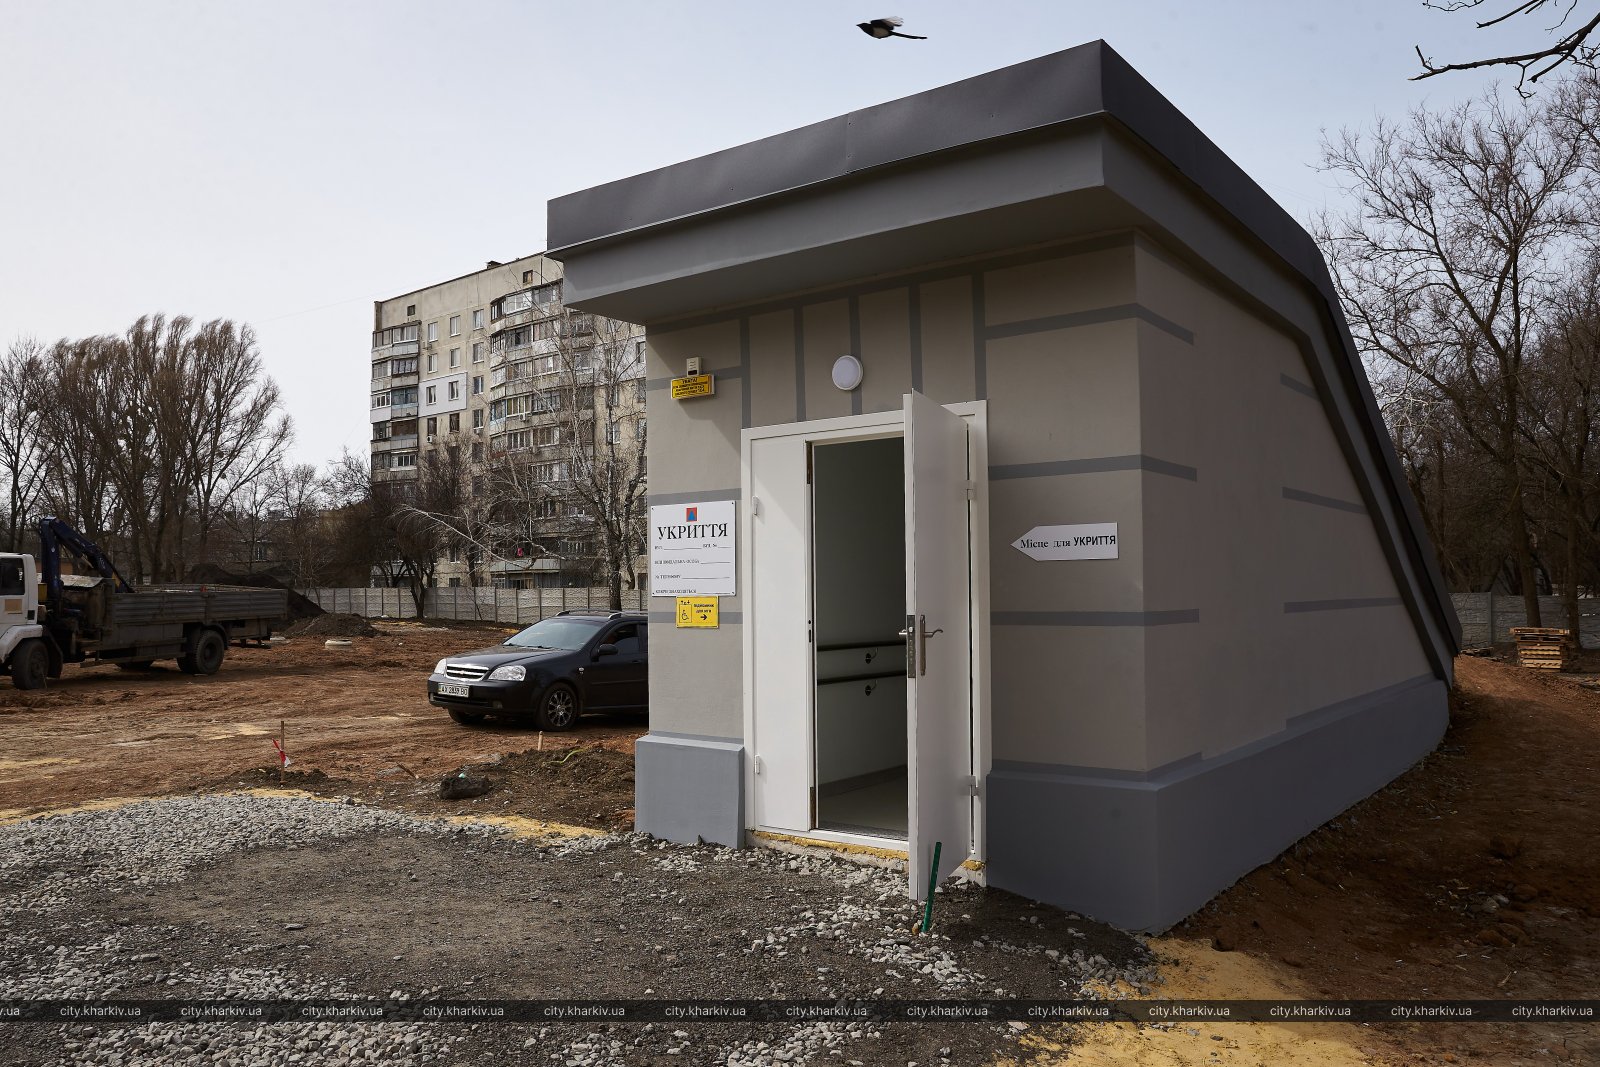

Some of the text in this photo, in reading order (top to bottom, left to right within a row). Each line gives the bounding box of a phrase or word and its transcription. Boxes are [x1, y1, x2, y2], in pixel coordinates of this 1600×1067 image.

[657, 523, 728, 540] УКРИТТЯ
[1020, 535, 1116, 549] Місце для УКРИТТЯ
